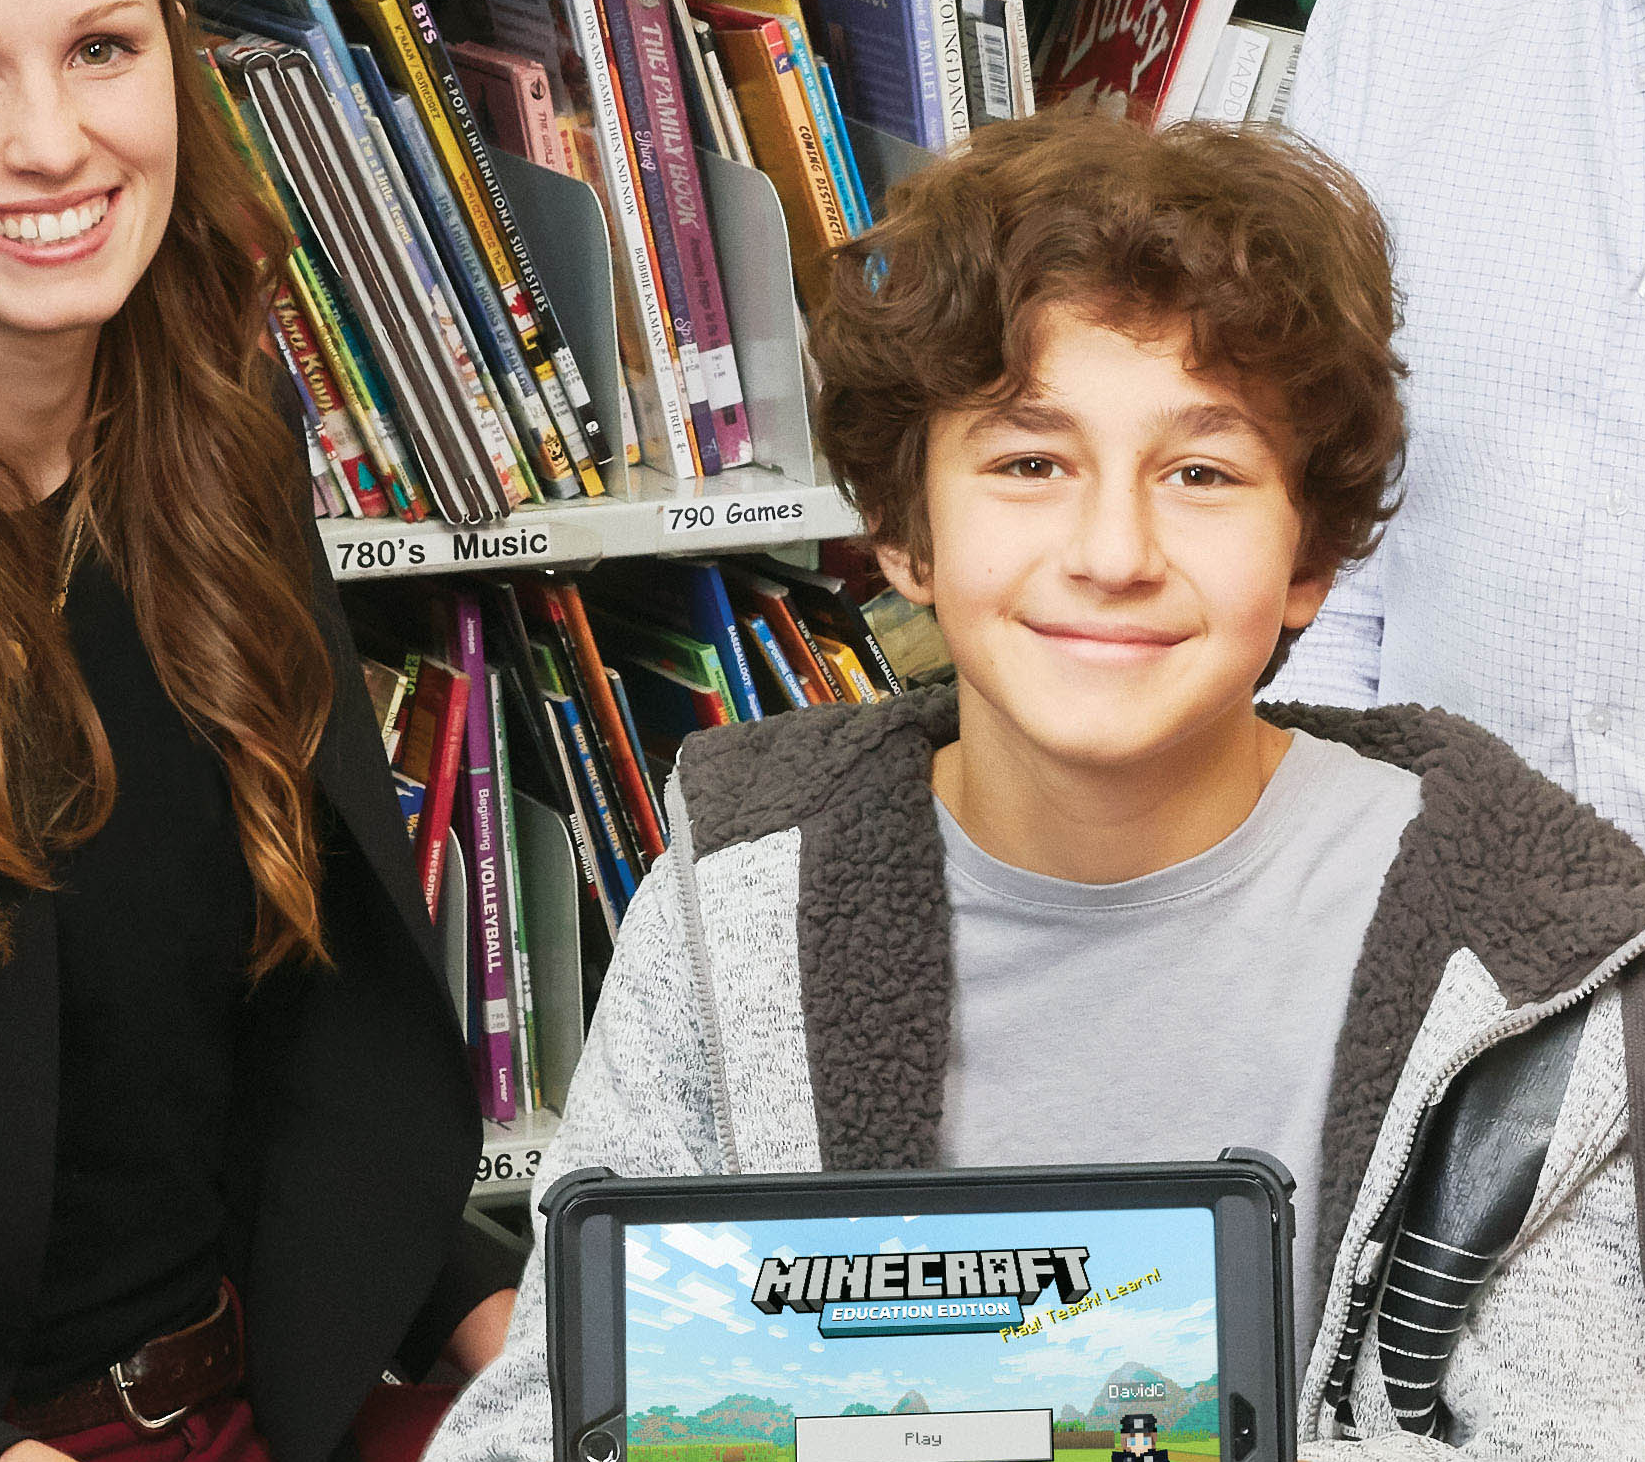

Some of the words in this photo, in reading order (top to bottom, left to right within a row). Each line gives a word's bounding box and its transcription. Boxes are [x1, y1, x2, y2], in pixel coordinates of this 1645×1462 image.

[411, 2, 437, 45] BTS
[583, 8, 598, 42] TOYS
[591, 45, 604, 71] AND
[643, 24, 666, 70] THE
[917, 38, 937, 101] BALLET
[596, 72, 615, 122] GAMES
[1222, 40, 1261, 117] MADD
[652, 72, 682, 158] FAMILY
[607, 123, 621, 157] THEN
[798, 125, 823, 172] COMING
[372, 167, 397, 202] Little
[443, 74, 472, 129] K-POP'S
[468, 130, 515, 234] INTERNATIONAL
[510, 234, 549, 314] SUPERSTARS
[614, 160, 628, 185] AND
[670, 161, 698, 227] BOOK
[622, 187, 635, 216] NOW
[632, 246, 652, 290] BOBBIE
[642, 292, 666, 347] KALMAN
[669, 505, 715, 531] 790
[726, 498, 803, 526] Games
[336, 536, 425, 571] 780's
[452, 528, 549, 561] Music
[477, 788, 492, 850] Beginning
[480, 856, 502, 972] VOLLEYBALL
[752, 1246, 1090, 1314] MINECRAFT
[831, 1302, 934, 1323] EDUCATION
[937, 1300, 1012, 1319] EDITION
[999, 1317, 1044, 1344] Play!
[1046, 1292, 1104, 1329] Teach!
[1106, 1266, 1163, 1306] Learn!
[1108, 1382, 1165, 1401] DavidC
[904, 1431, 943, 1449] Play
